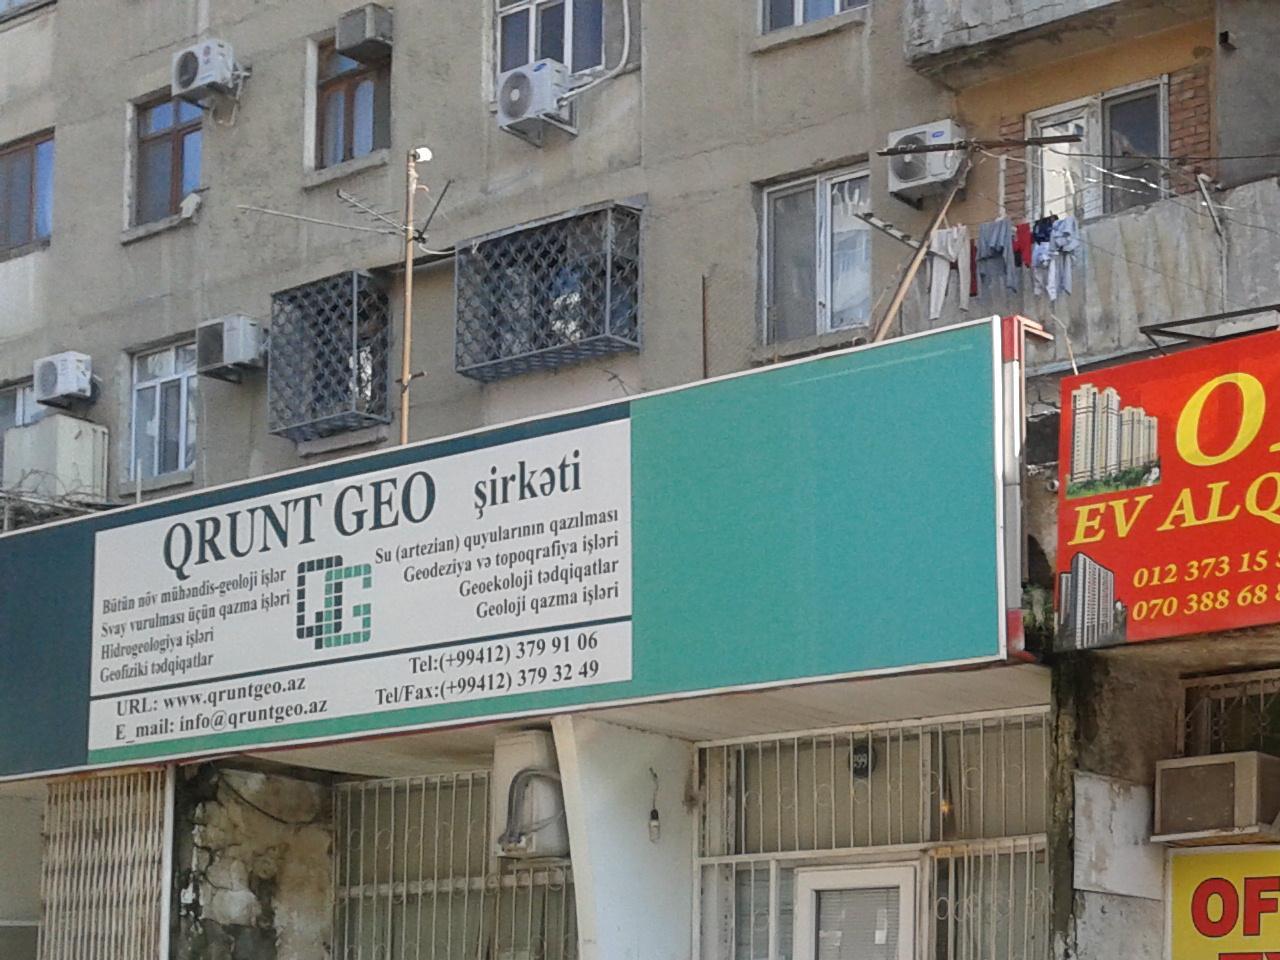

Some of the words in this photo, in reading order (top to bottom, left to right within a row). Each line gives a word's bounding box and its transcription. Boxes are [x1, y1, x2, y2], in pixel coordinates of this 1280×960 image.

[164, 492, 323, 580] QRUNT
[334, 470, 436, 537] GEO
[474, 449, 581, 519] şirkəti
[1067, 493, 1154, 546] EV
[375, 548, 392, 565] Su
[395, 535, 460, 563] (artezian)
[464, 522, 545, 551] quyularının
[550, 509, 619, 535] qazılması
[403, 560, 472, 583] Geodeziya
[477, 556, 492, 569] və
[495, 540, 578, 569] topoqrafiya
[582, 530, 619, 556] işləri
[459, 573, 533, 597] Geoekoloji
[537, 558, 620, 585] tədqiqatlar
[1133, 565, 1177, 588] 012
[1184, 555, 1230, 582] 373
[1238, 550, 1268, 573] 15
[103, 595, 135, 614] Bütün
[138, 592, 157, 608] növ
[161, 573, 258, 604] mühəndis-geoloji
[261, 568, 286, 587] işlər
[476, 597, 526, 619] Geoloji
[530, 592, 578, 612] qazma
[582, 581, 619, 606] işləri
[1132, 597, 1178, 621] 070
[1184, 587, 1230, 615] 388
[1236, 583, 1268, 606] 68
[101, 622, 127, 638] Svay
[130, 613, 185, 632] vurulması
[188, 602, 215, 622] üçün
[219, 599, 257, 620] qazma
[261, 589, 291, 612] işləri
[101, 635, 183, 660] Hidrogeologiya
[186, 627, 214, 647] işləri
[409, 644, 511, 674] Tel:(+99412)
[516, 638, 546, 660] 379
[552, 635, 570, 653] 91
[577, 631, 598, 650] 06
[100, 661, 148, 683] Geofiziki
[152, 653, 214, 675] tədqiqatlar
[375, 672, 512, 706] Tel/Fax:(+99412)
[517, 666, 547, 687] 379
[552, 663, 573, 682] 32
[578, 659, 599, 679] 49
[117, 697, 159, 717] URL:
[163, 677, 306, 709] www.qruntgeo.az
[116, 719, 175, 744] E_mail:
[180, 700, 328, 731] info@qruntgeo.az
